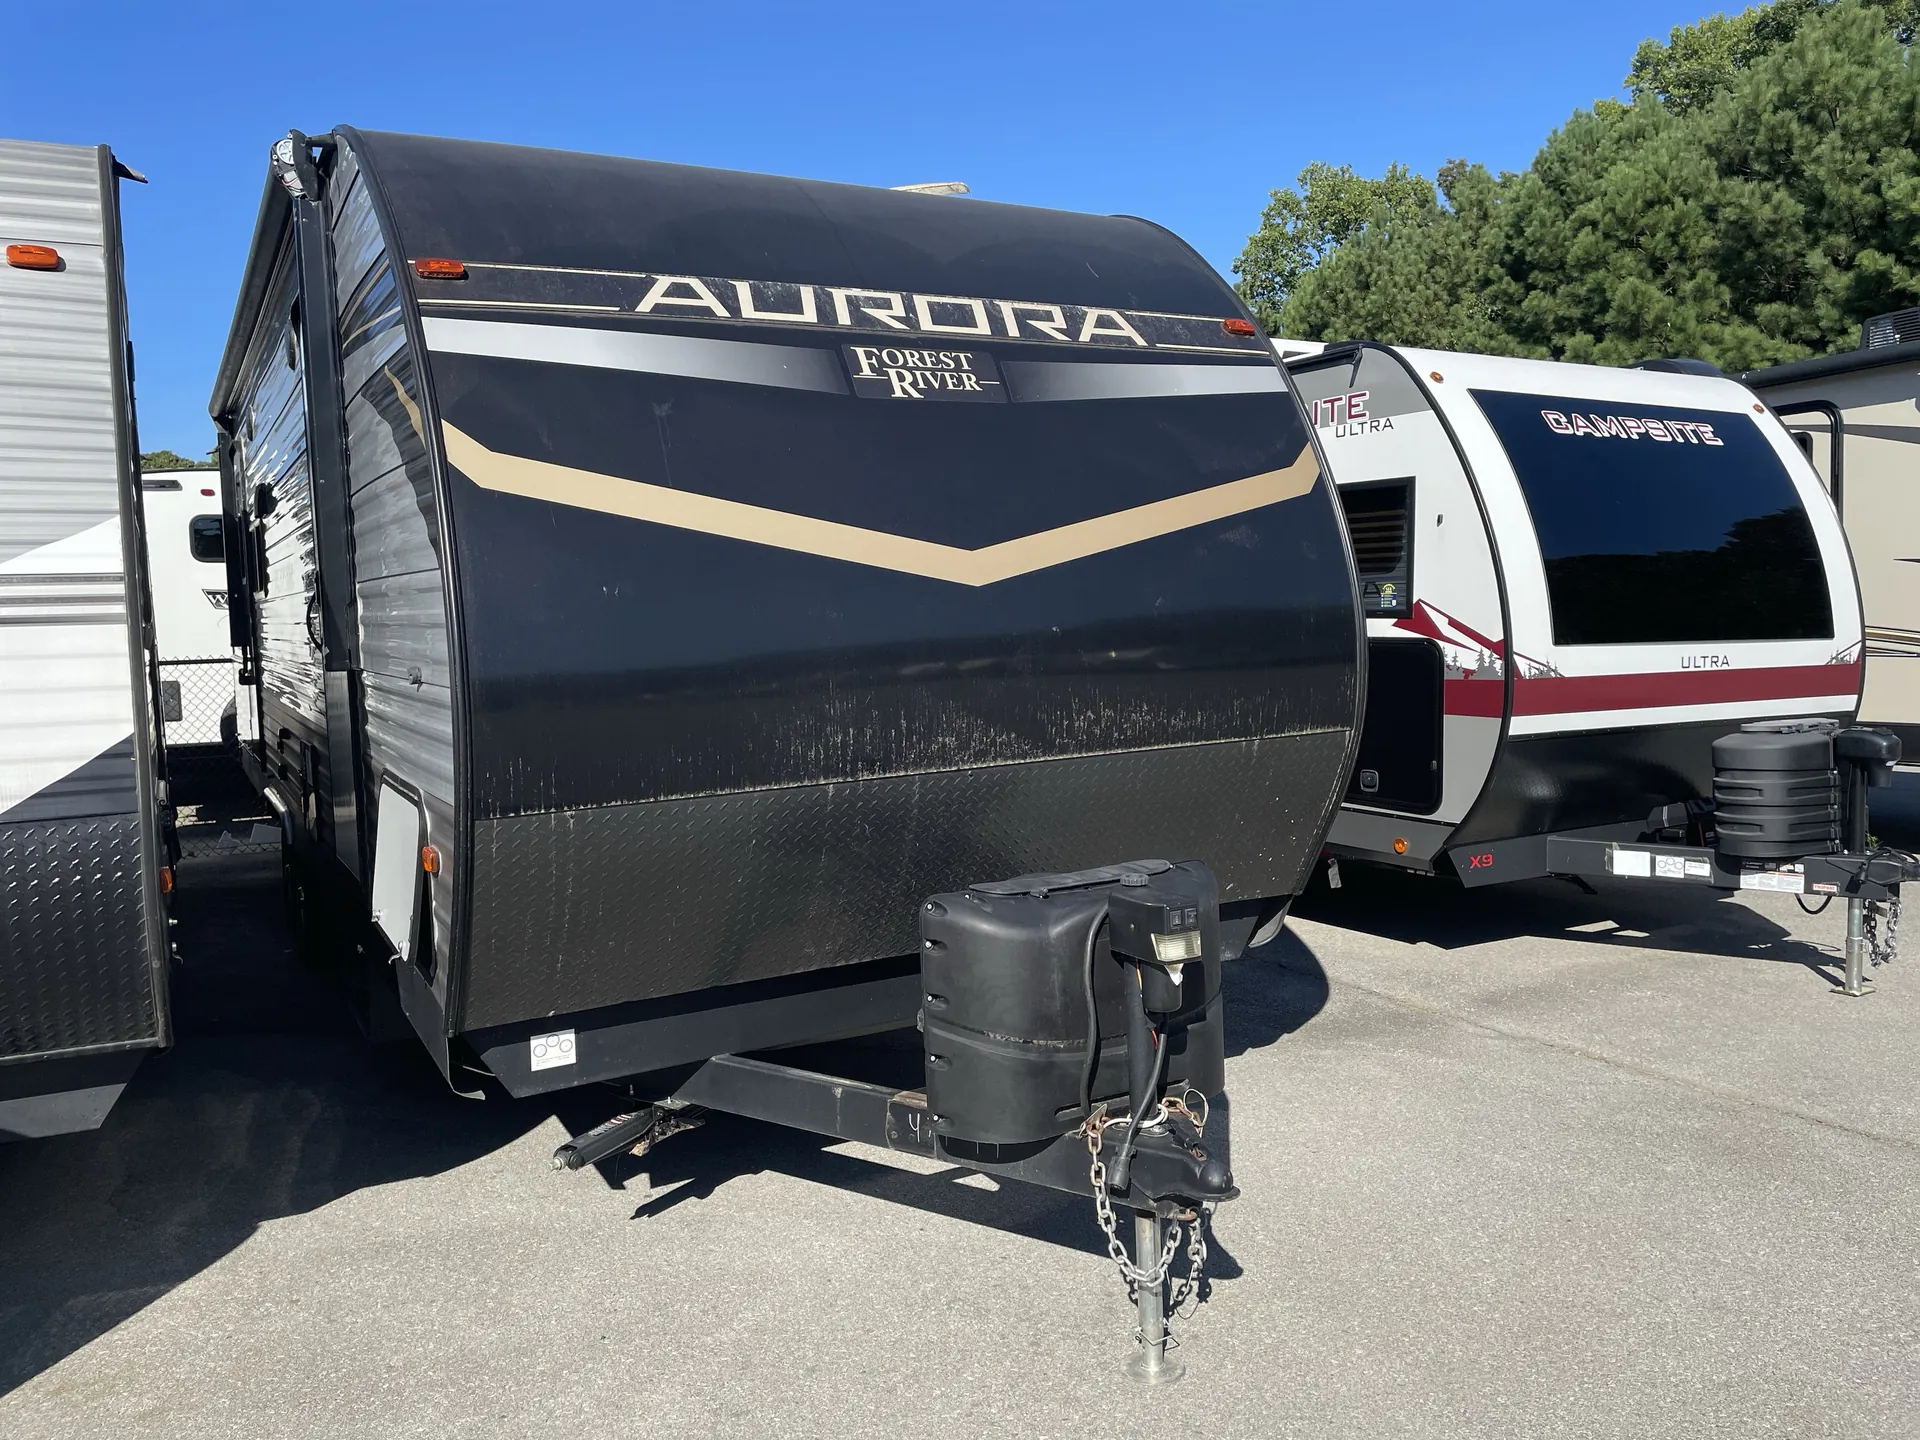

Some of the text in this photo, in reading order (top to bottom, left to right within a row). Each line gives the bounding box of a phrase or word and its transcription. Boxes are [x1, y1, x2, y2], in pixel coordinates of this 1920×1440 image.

[635, 274, 1149, 347] AURORA
[850, 346, 974, 377] FOREST
[882, 367, 984, 399] RIVER
[1335, 417, 1395, 438] ULTRA
[1541, 410, 1724, 446] CAMPSITE
[1681, 654, 1730, 669] ULTRA
[1467, 851, 1493, 870] X9
